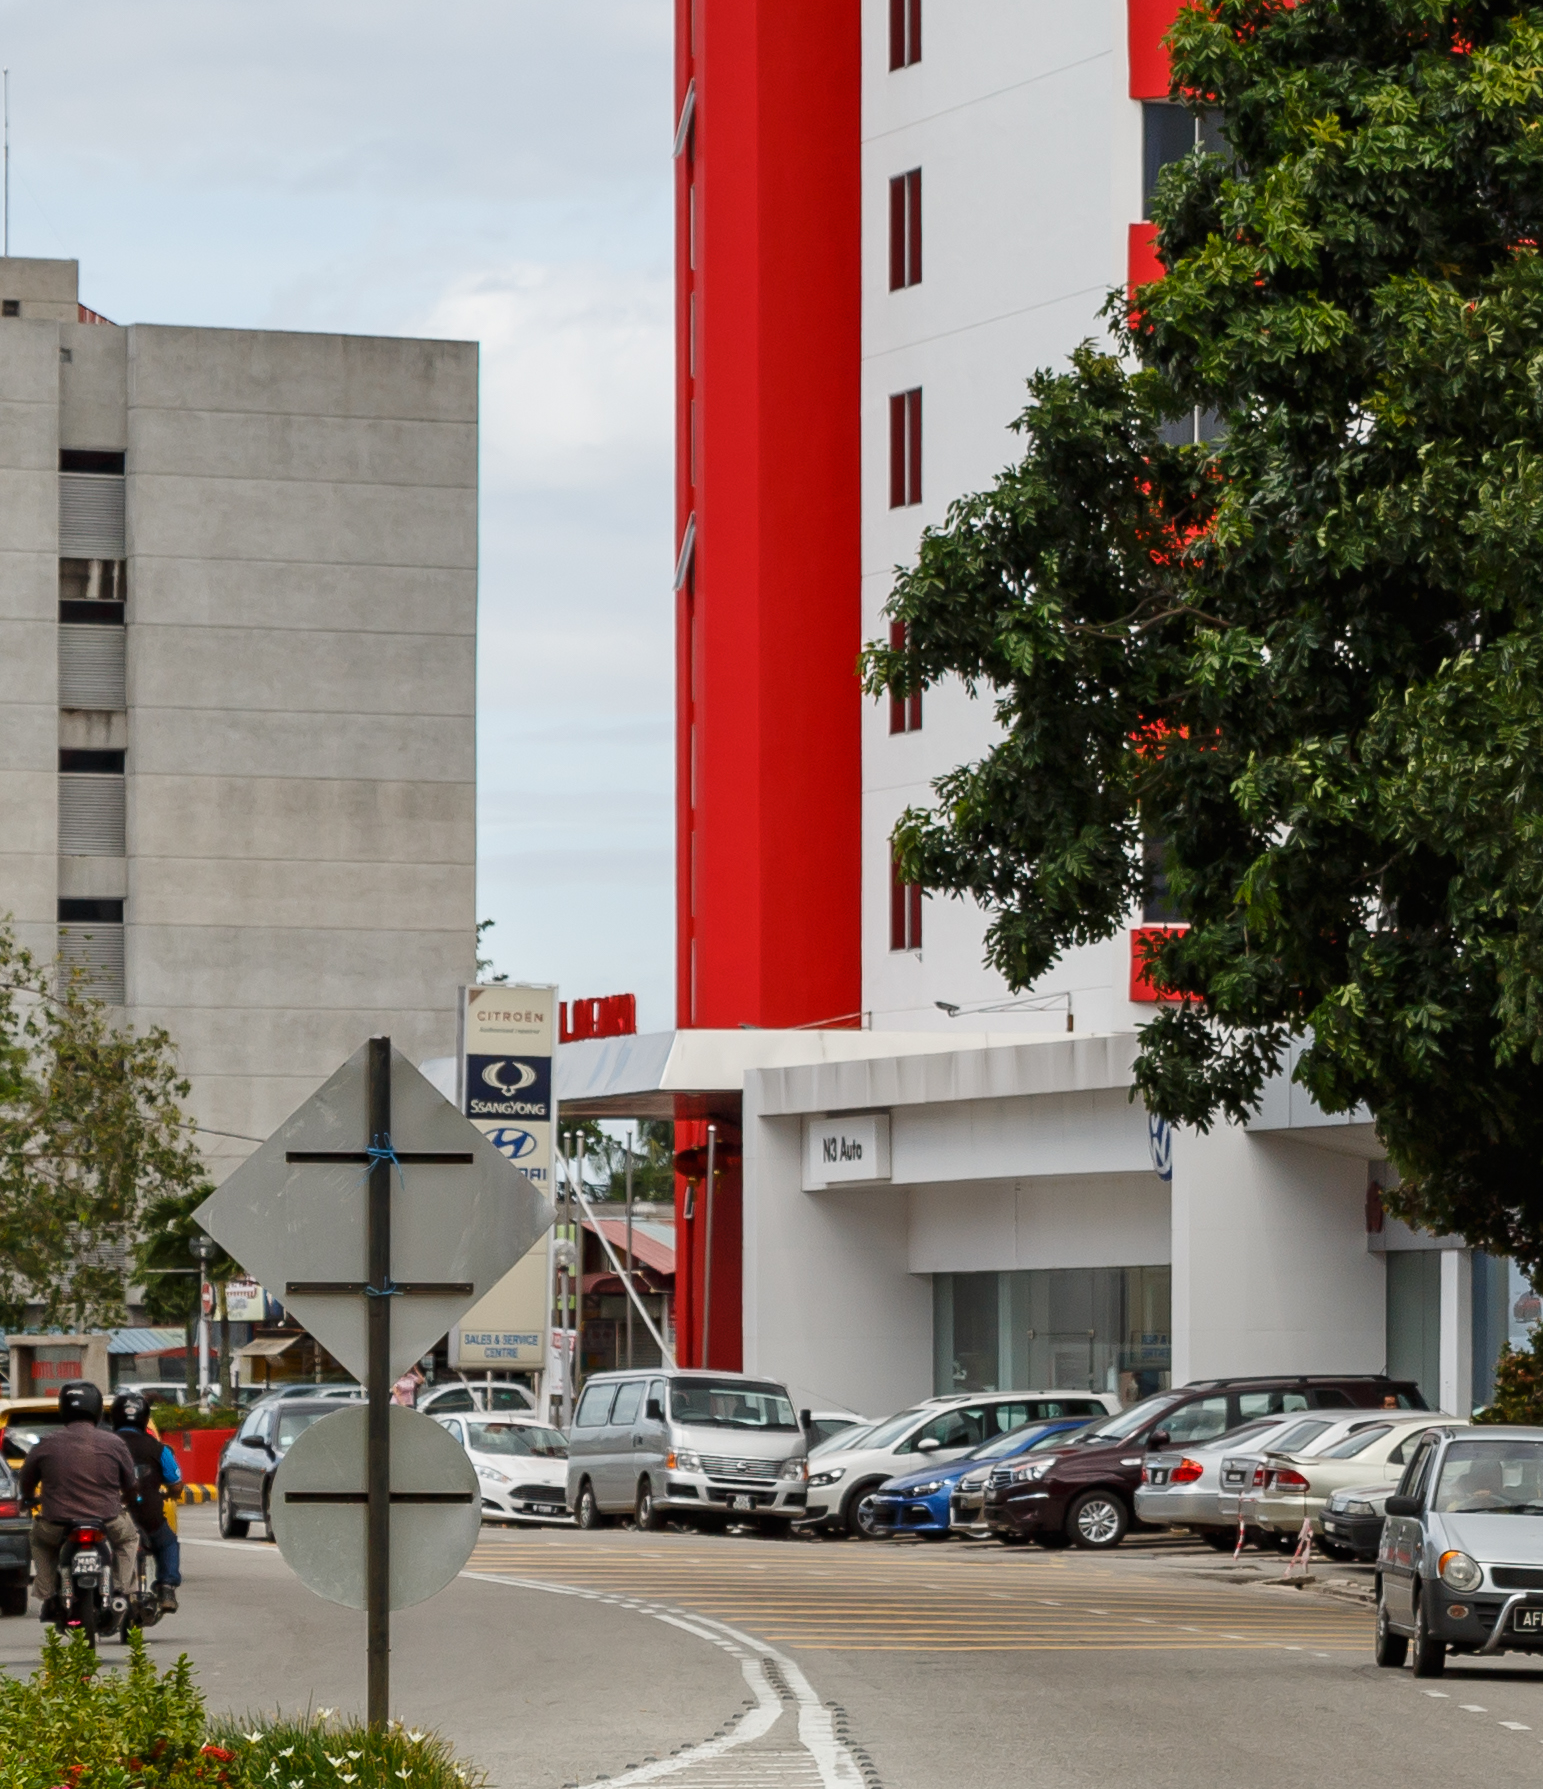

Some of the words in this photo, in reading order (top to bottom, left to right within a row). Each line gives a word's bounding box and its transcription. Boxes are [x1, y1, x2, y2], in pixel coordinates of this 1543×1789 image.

[477, 1010, 544, 1023] CITROËN
[822, 1136, 837, 1163] N3
[840, 1136, 863, 1161] Auto
[464, 1334, 492, 1345] SALES
[493, 1334, 500, 1345] &
[502, 1335, 538, 1346] SERVICE
[484, 1347, 518, 1358] CENTRE
